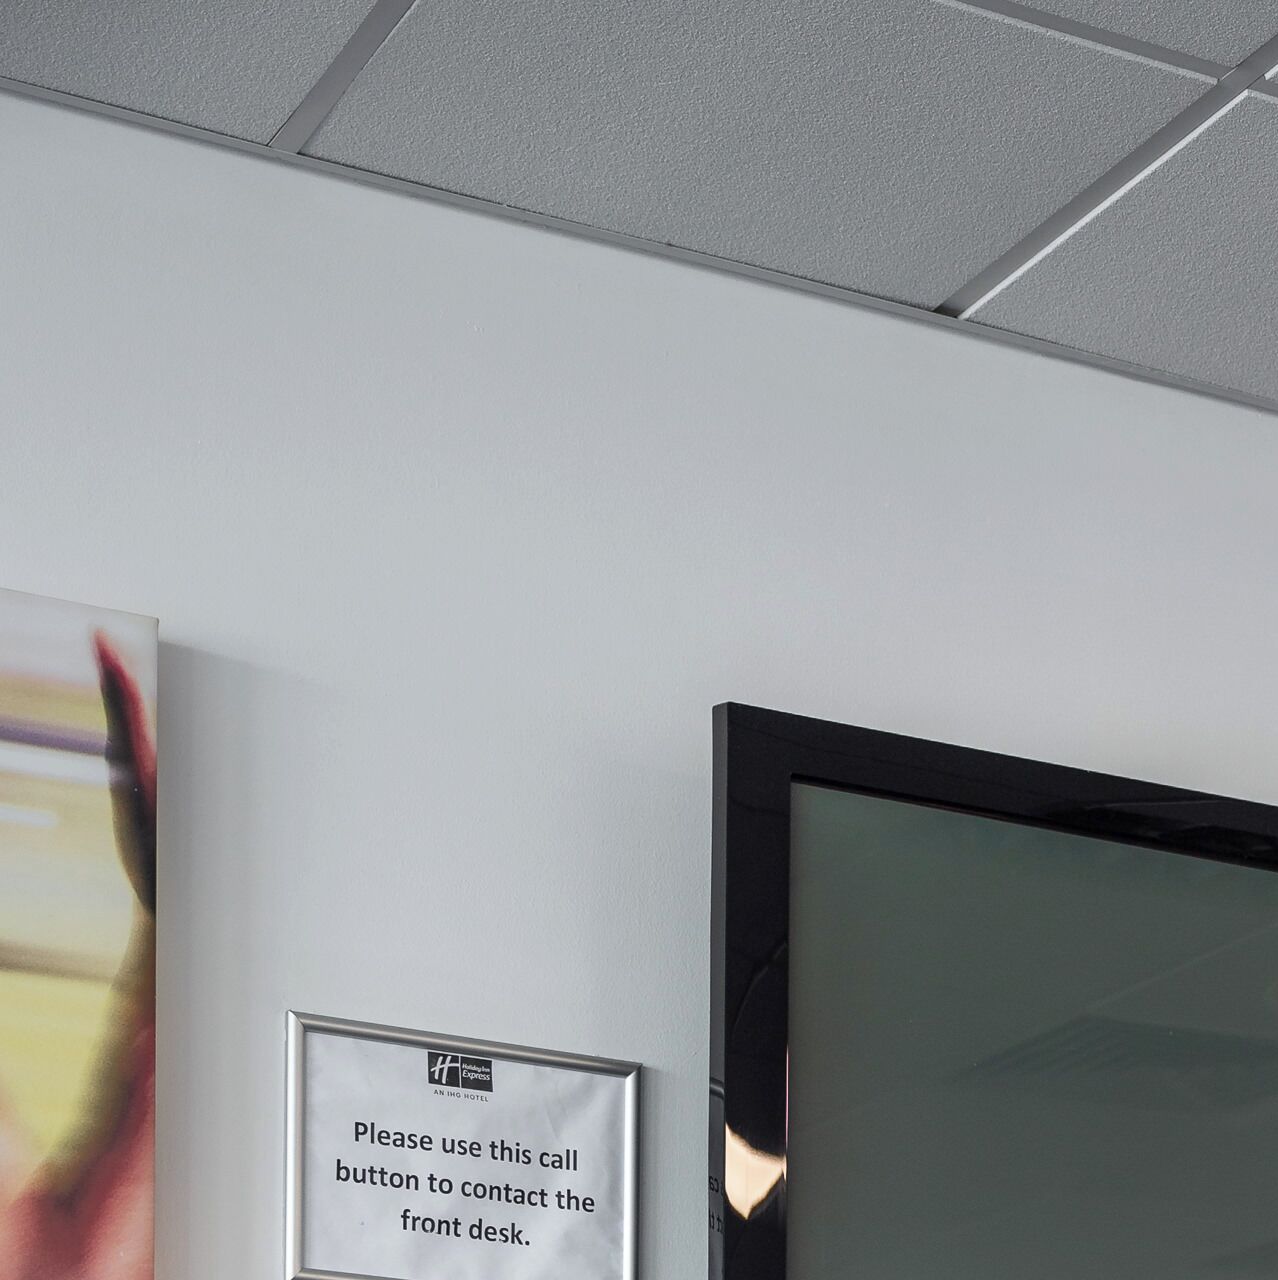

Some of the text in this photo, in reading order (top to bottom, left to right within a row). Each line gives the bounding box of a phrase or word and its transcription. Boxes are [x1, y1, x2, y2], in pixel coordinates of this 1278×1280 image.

[462, 1069, 490, 1080] Express
[464, 1093, 489, 1103] HOTEL
[354, 1121, 578, 1171] Please use this call
[336, 1158, 595, 1213] button to contact the
[400, 1208, 530, 1246] front desk.
